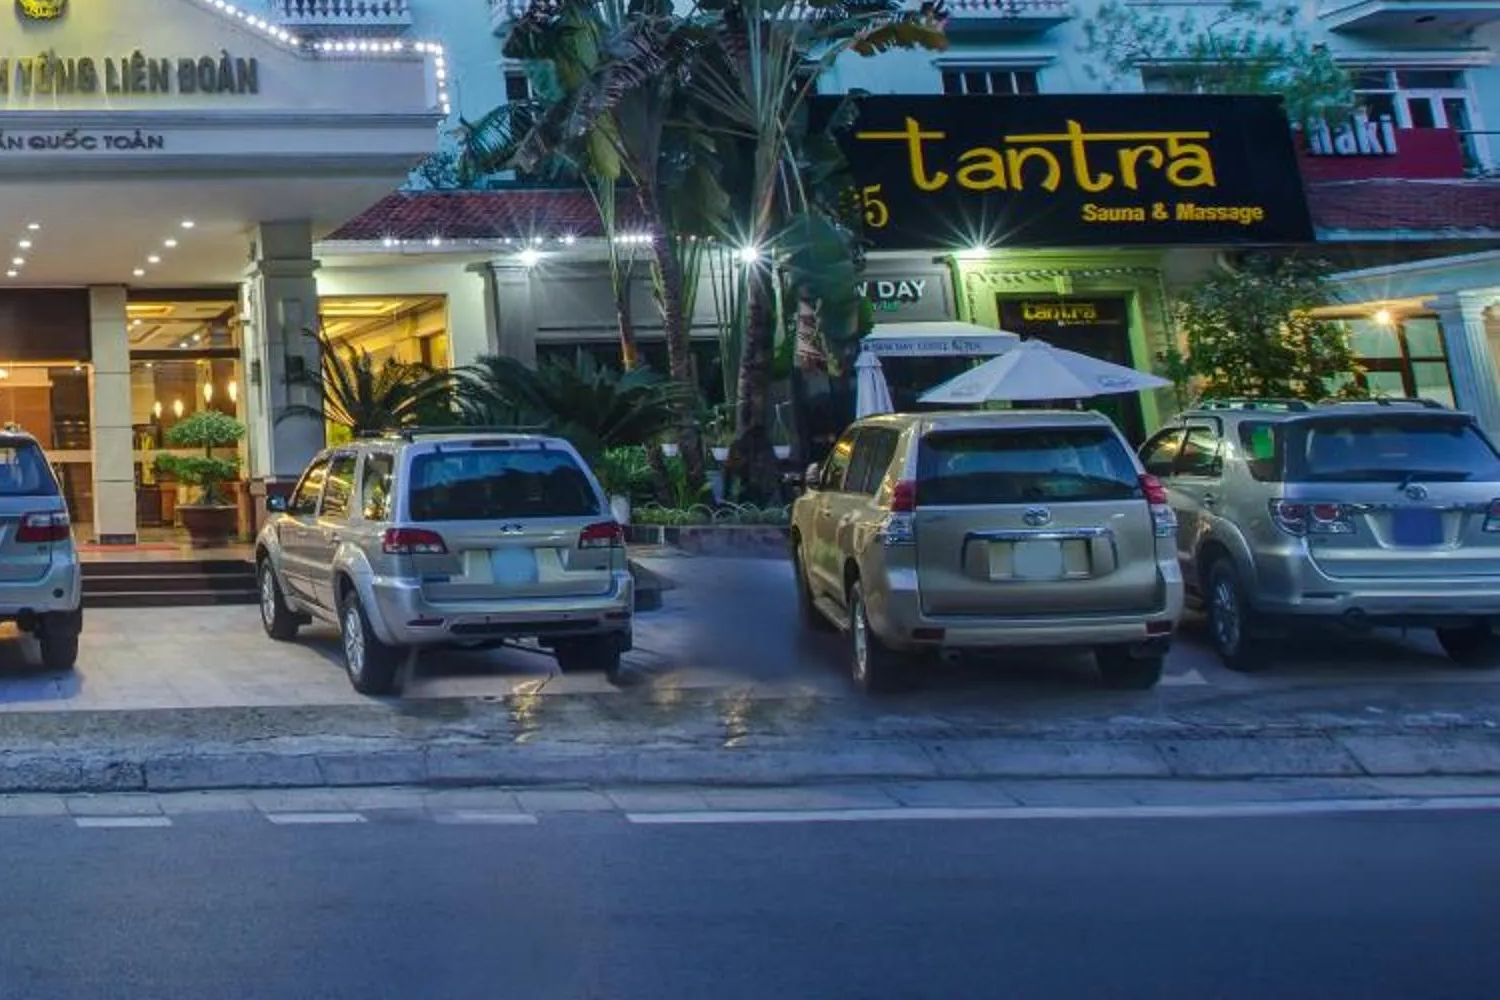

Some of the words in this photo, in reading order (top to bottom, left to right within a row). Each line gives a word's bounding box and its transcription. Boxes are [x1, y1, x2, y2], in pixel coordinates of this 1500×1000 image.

[104, 50, 169, 94] LIÊN
[177, 49, 259, 94] ĐOÀN
[28, 128, 98, 151] QUỐC
[856, 117, 1216, 193] tantra
[1082, 203, 1145, 221] Sauna
[1152, 202, 1169, 221] &
[1175, 203, 1264, 225] Massage
[877, 279, 927, 298] DAY
